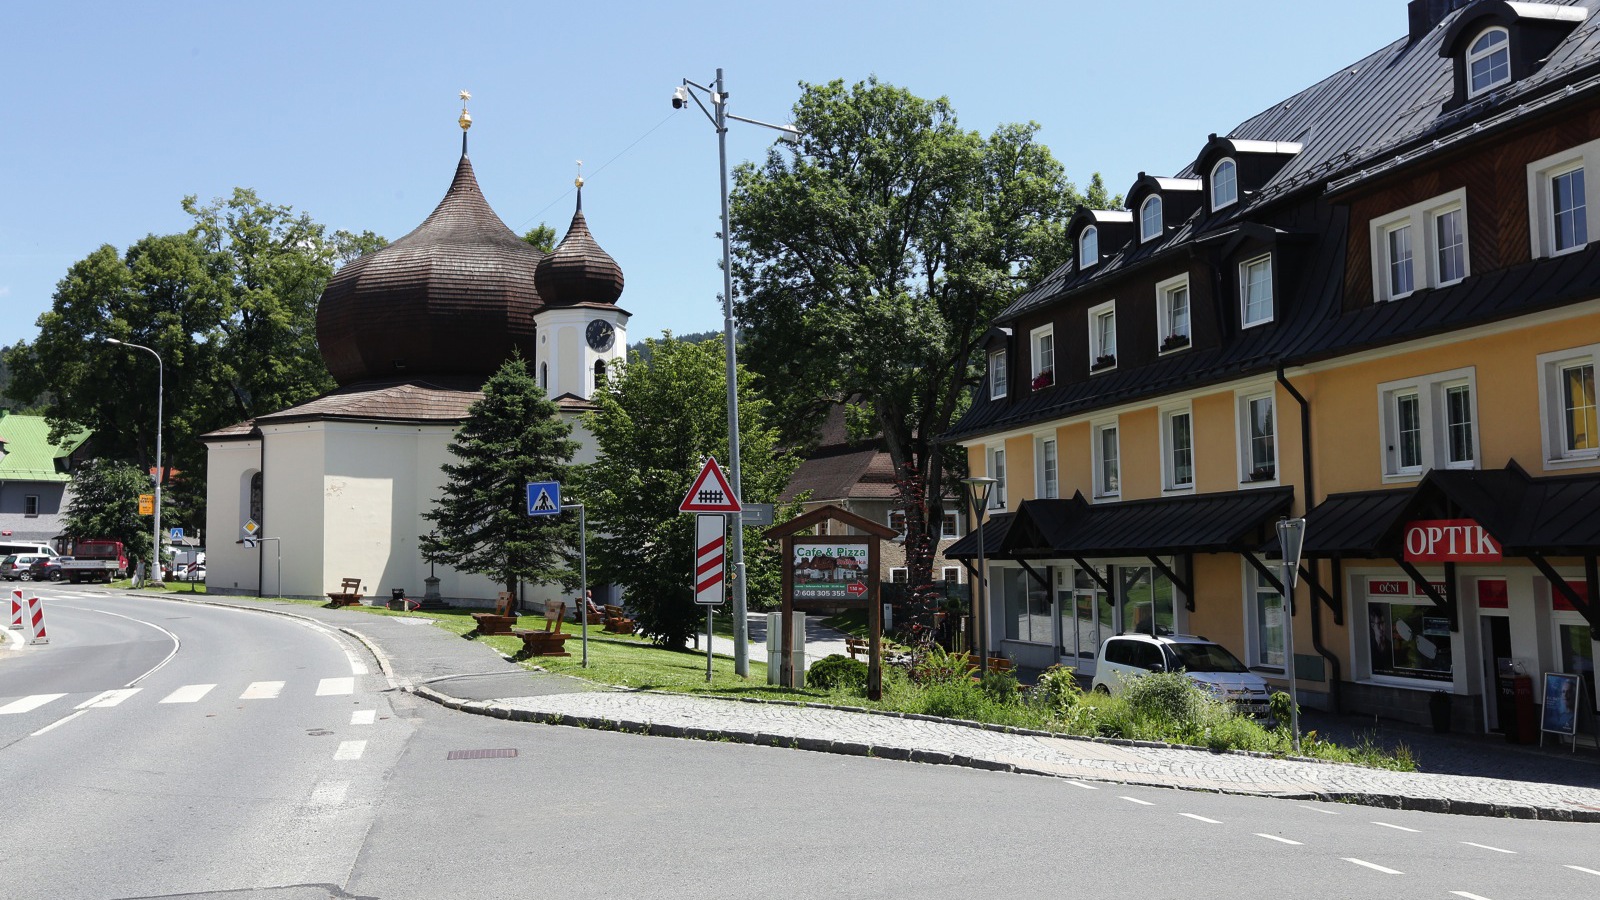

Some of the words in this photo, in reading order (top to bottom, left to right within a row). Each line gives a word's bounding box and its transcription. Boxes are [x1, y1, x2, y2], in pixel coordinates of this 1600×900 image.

[1406, 525, 1499, 555] OPTIK
[797, 547, 822, 557] Cafe
[826, 547, 834, 557] &
[837, 547, 866, 557] Pizza
[1379, 582, 1399, 593] OČNÍ
